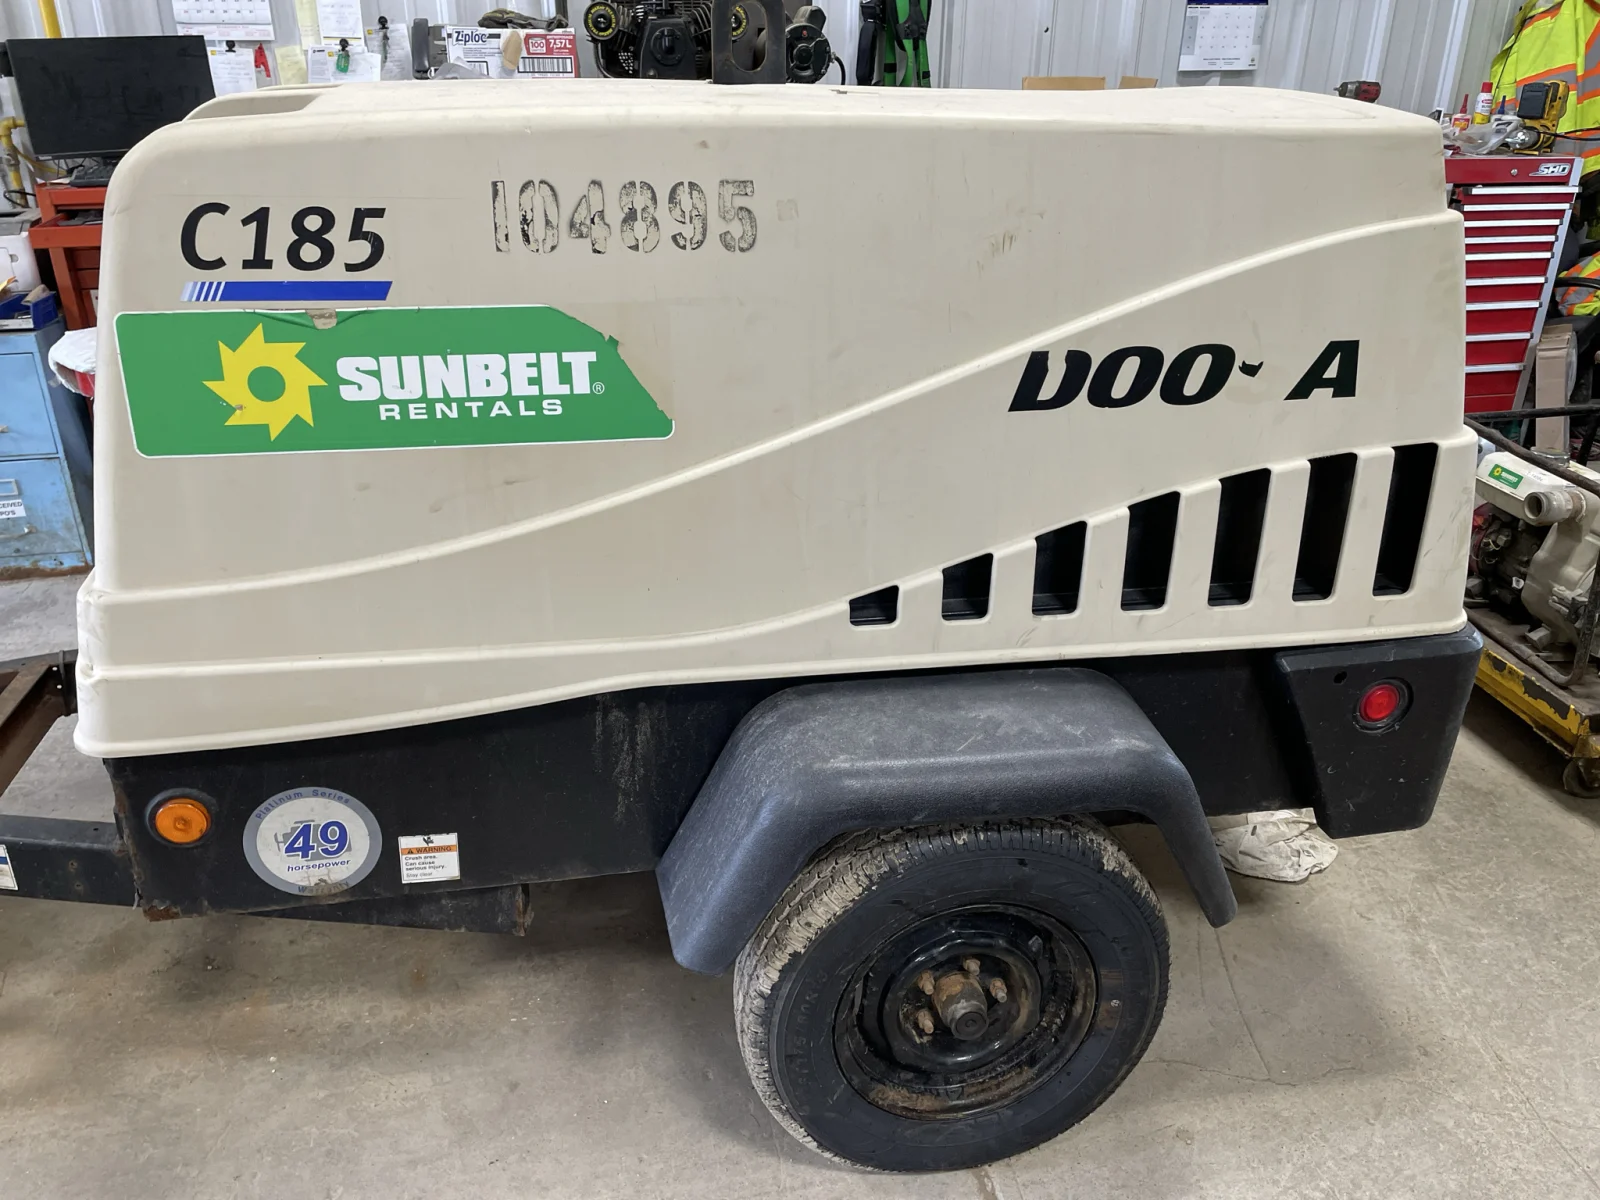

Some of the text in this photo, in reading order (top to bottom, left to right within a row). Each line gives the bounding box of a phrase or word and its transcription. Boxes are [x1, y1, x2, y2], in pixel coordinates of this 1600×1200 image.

[454, 30, 488, 46] Ziploc
[530, 40, 545, 49] 100
[491, 179, 758, 254] 104895
[180, 202, 387, 273] C185
[336, 351, 597, 402] SUNBELT
[379, 399, 563, 421] RENTALS
[255, 789, 351, 820] Platinum Series
[284, 820, 350, 860] 49
[415, 846, 452, 854] WARNING
[287, 859, 351, 872] horsepower
